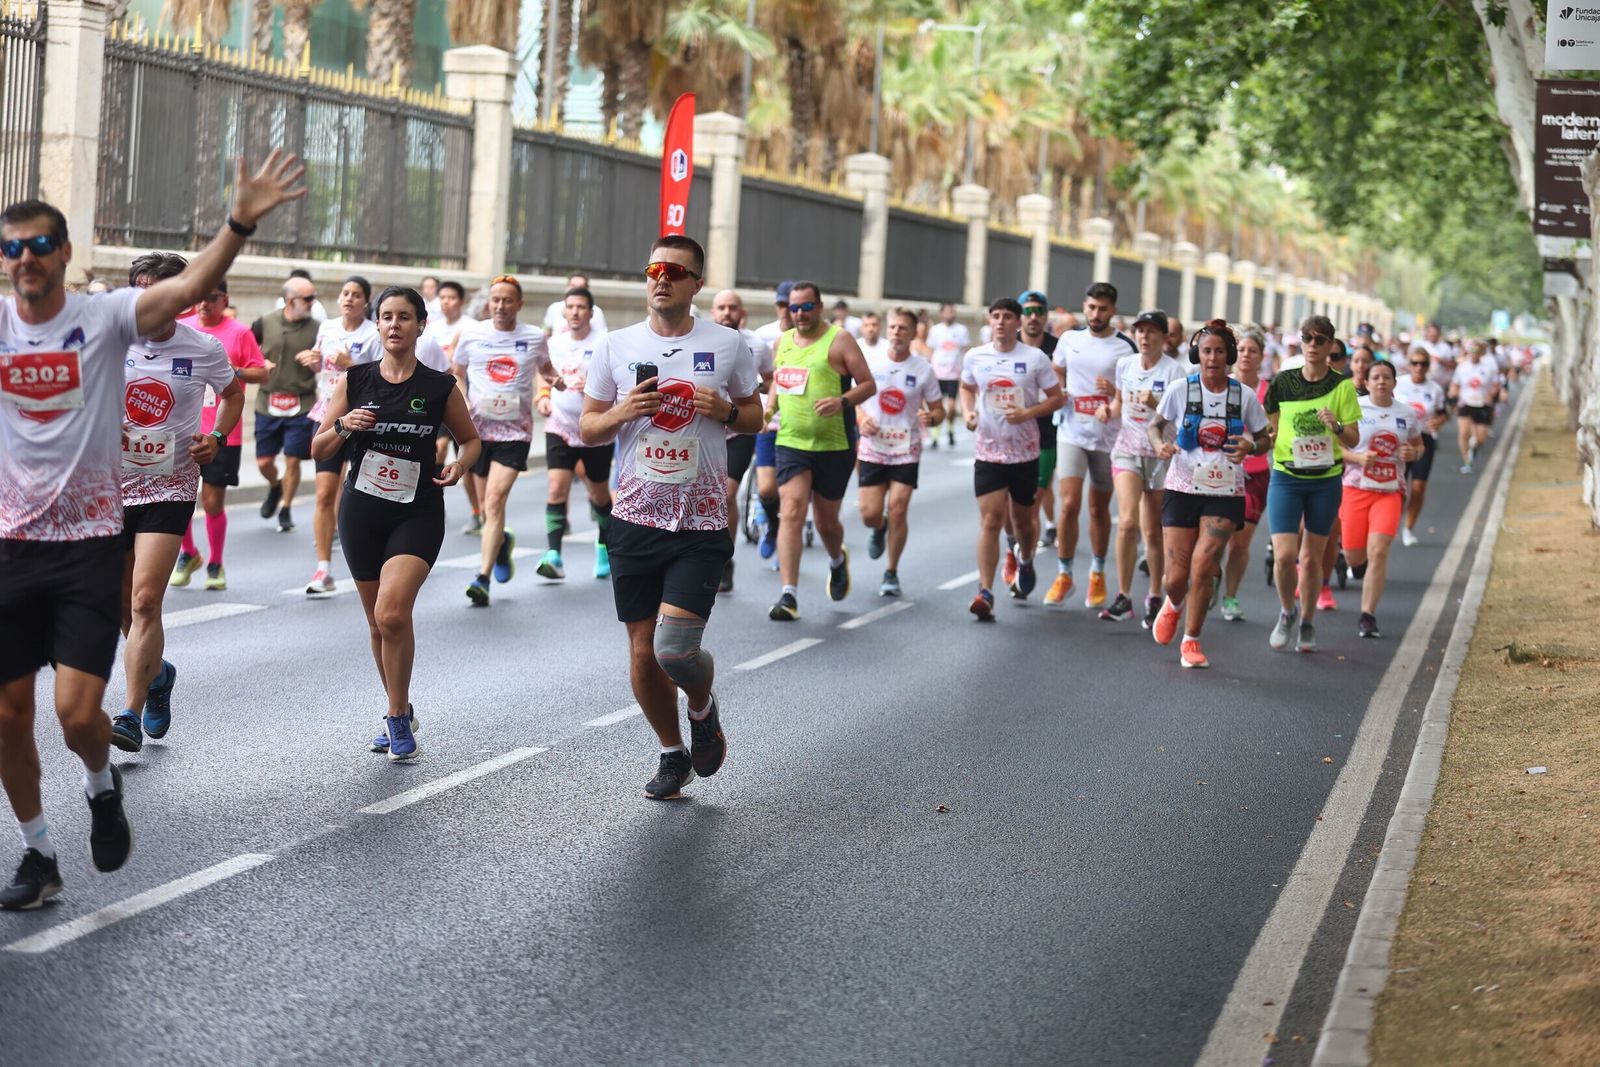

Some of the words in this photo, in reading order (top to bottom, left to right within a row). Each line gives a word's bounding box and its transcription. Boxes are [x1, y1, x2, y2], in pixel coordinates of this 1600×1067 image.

[694, 361, 711, 370] AXA
[10, 365, 70, 384] 2302
[131, 387, 168, 409] PONLE
[492, 399, 507, 407] 73
[127, 396, 163, 418] FRENO
[658, 402, 689, 419] RENO
[371, 441, 411, 453] PRIMOR
[645, 446, 689, 461] 1044
[378, 465, 400, 480] 26
[1207, 470, 1223, 479] 36
